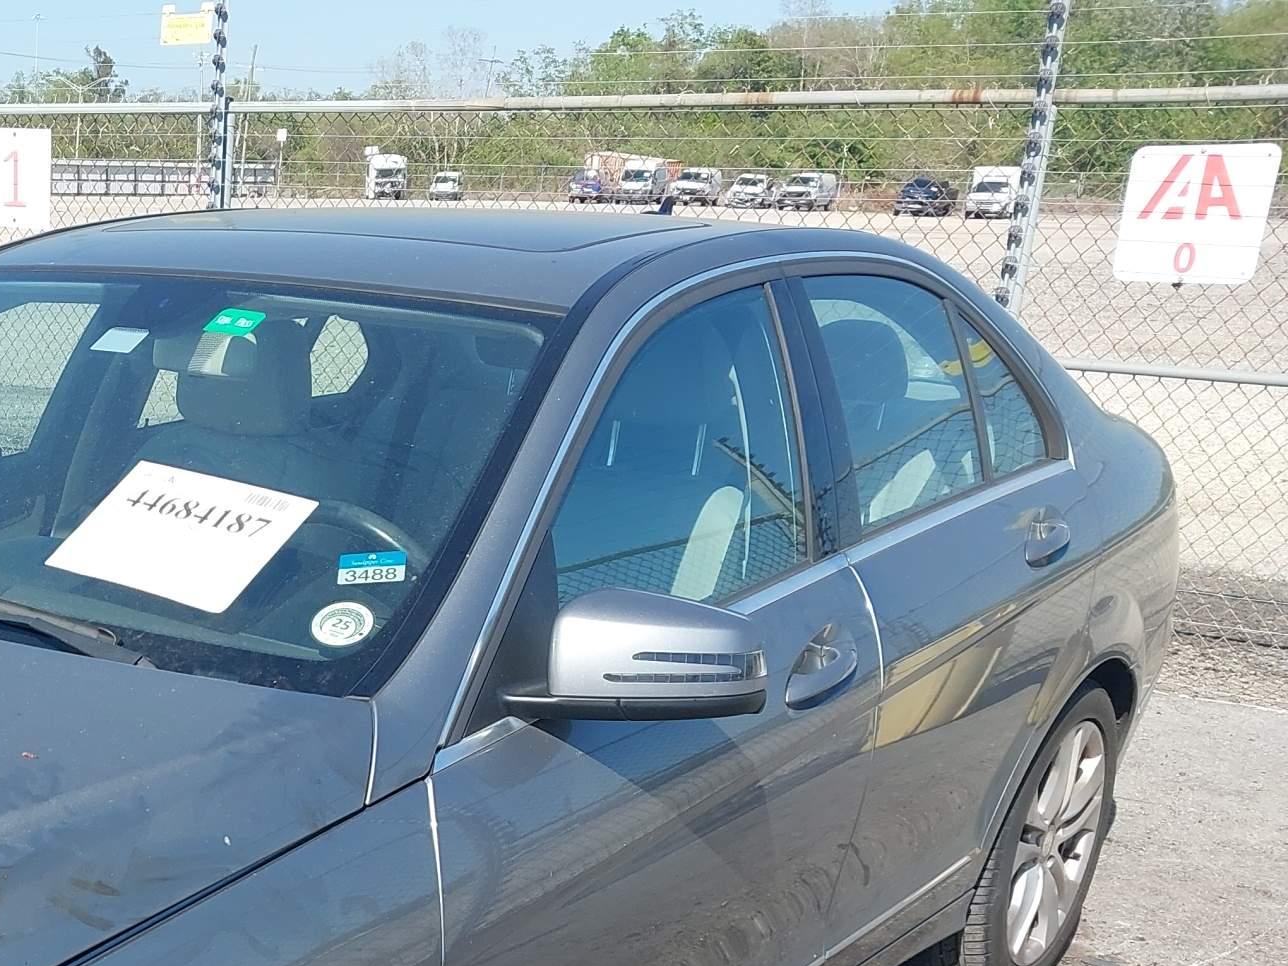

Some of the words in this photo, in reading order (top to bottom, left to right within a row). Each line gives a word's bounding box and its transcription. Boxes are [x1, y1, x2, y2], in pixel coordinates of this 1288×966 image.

[4, 151, 26, 207] 1
[1173, 242, 1196, 273] 0
[127, 489, 272, 537] 44684187
[344, 567, 397, 583] 3488
[332, 618, 351, 630] 25
